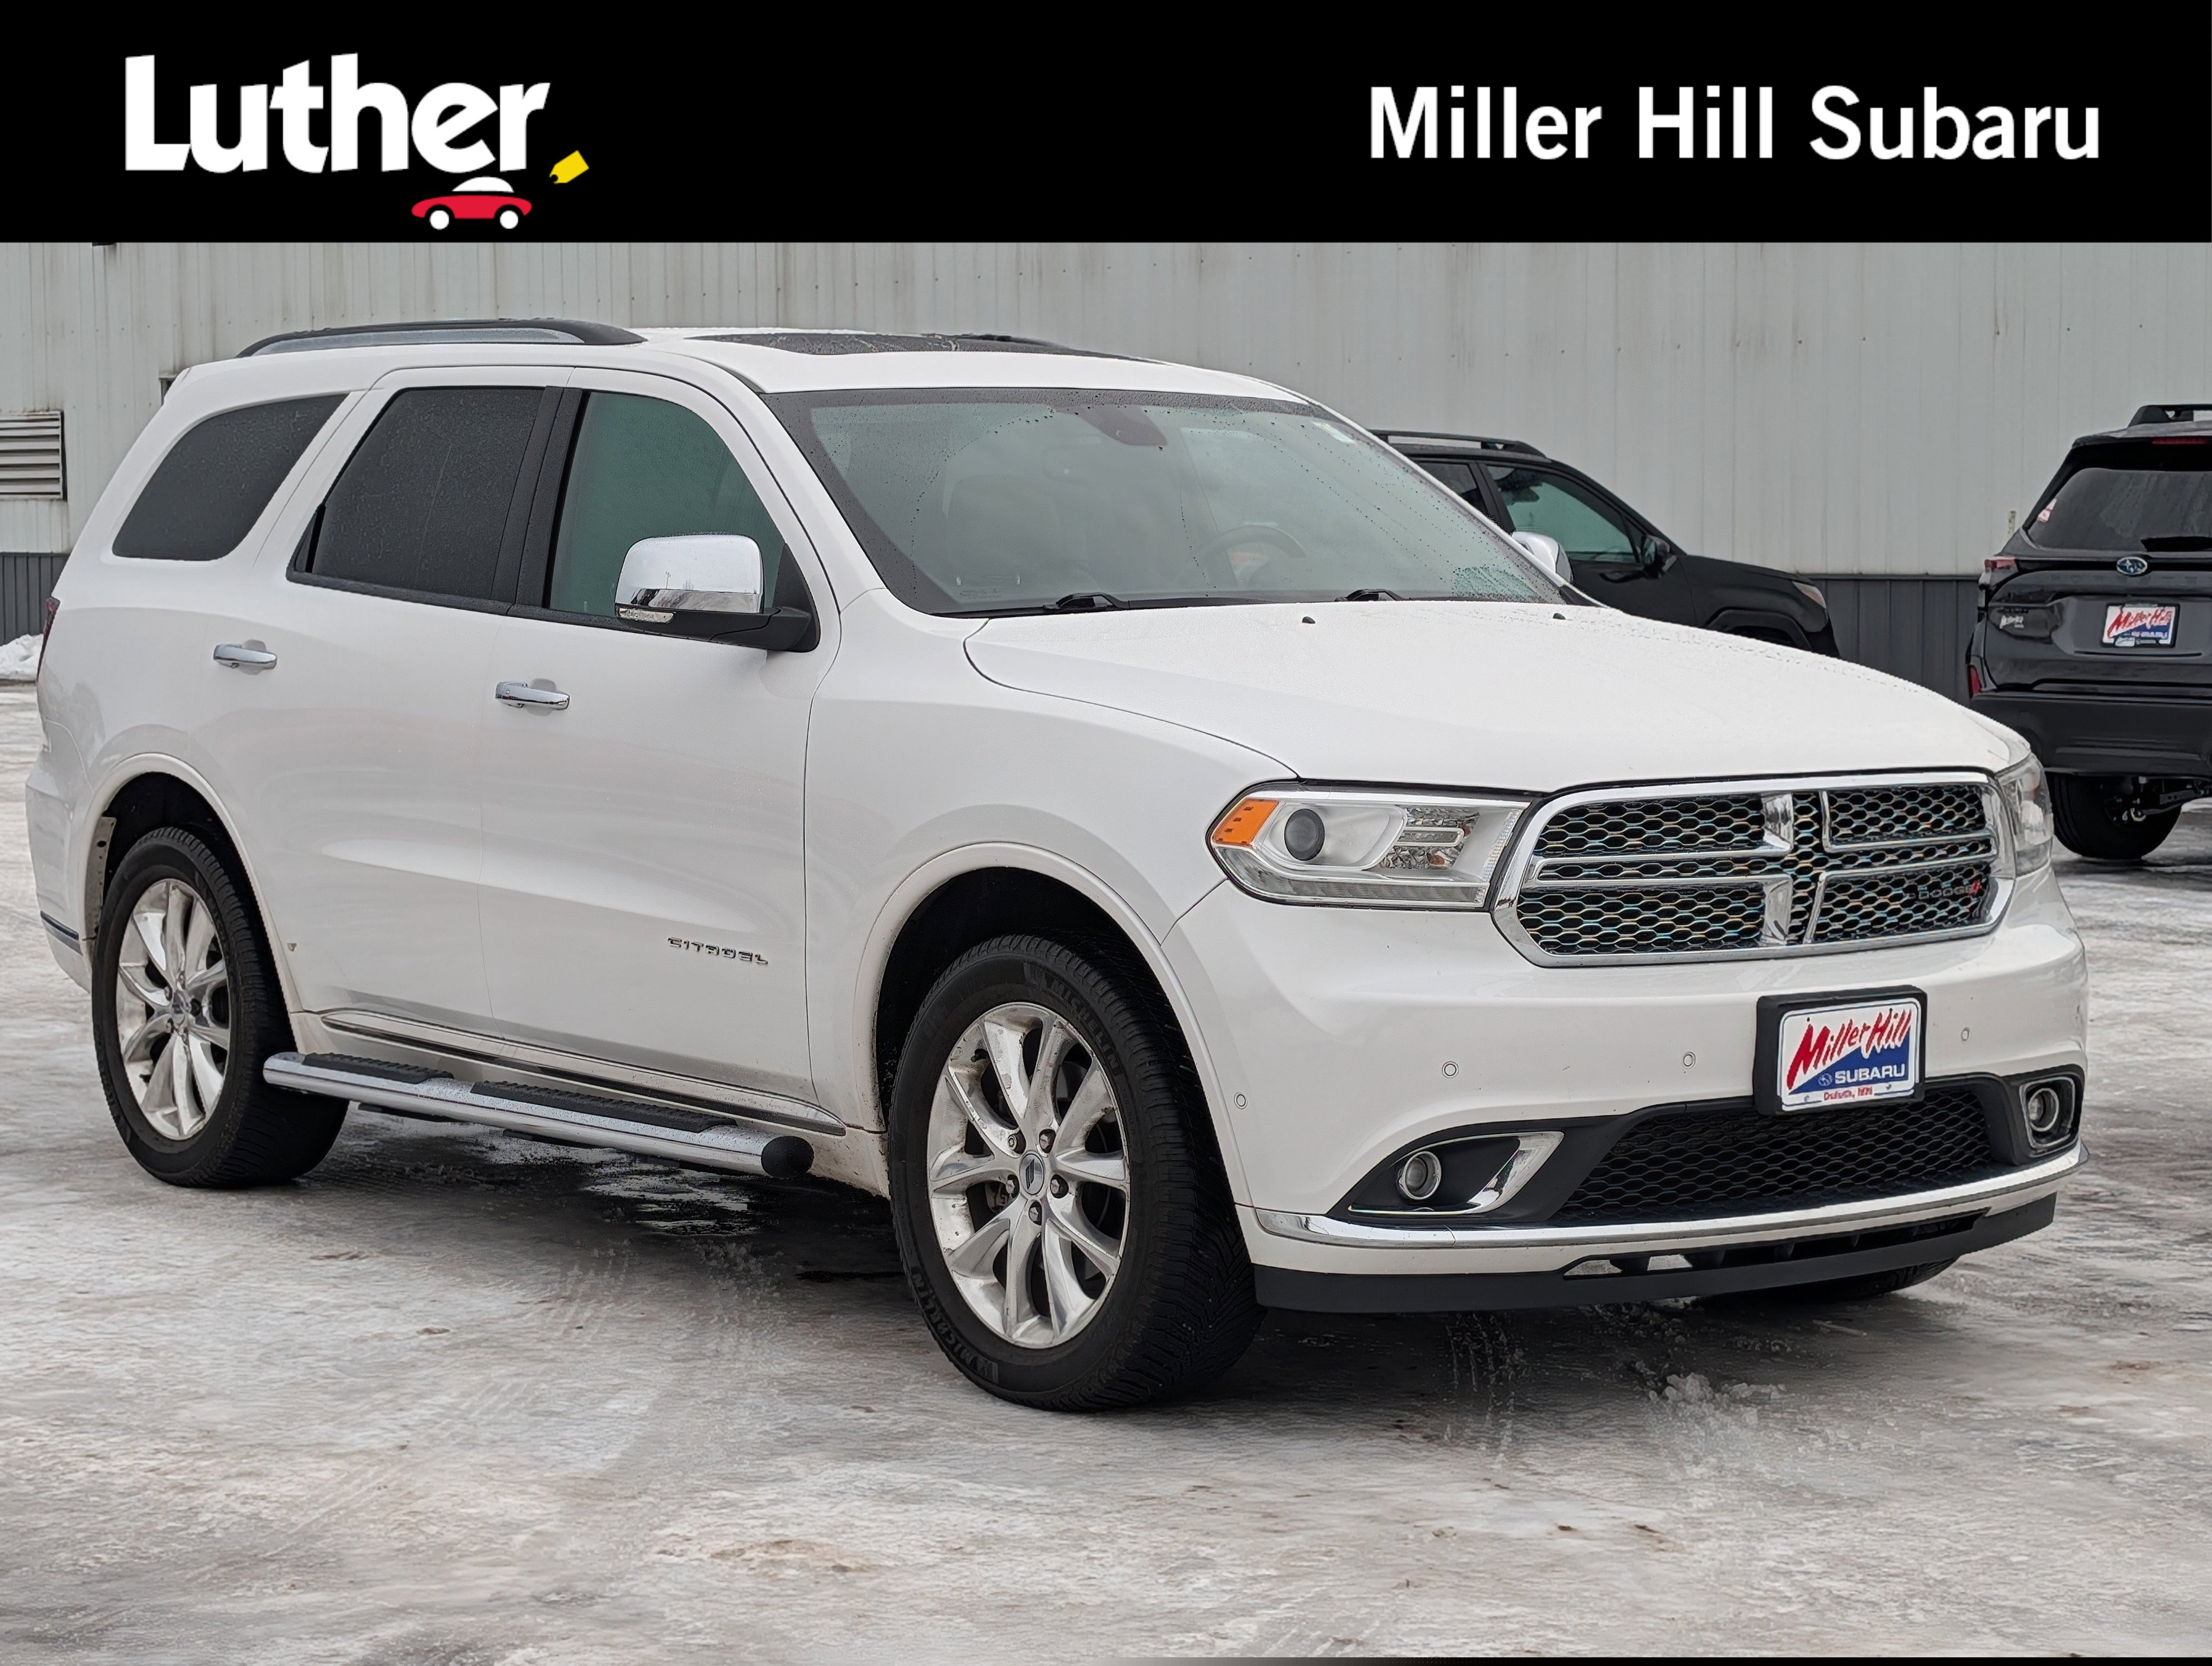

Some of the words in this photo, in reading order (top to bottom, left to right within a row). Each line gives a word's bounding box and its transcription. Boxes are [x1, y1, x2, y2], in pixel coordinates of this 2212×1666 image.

[667, 937, 769, 965] CITADEL
[1047, 978, 1121, 1071] MICHELIN
[1787, 1018, 1870, 1090] Miller
[1866, 1009, 1912, 1053] Hill
[1835, 1063, 1905, 1084] SUBARU
[912, 1272, 973, 1364] MICHELIN
